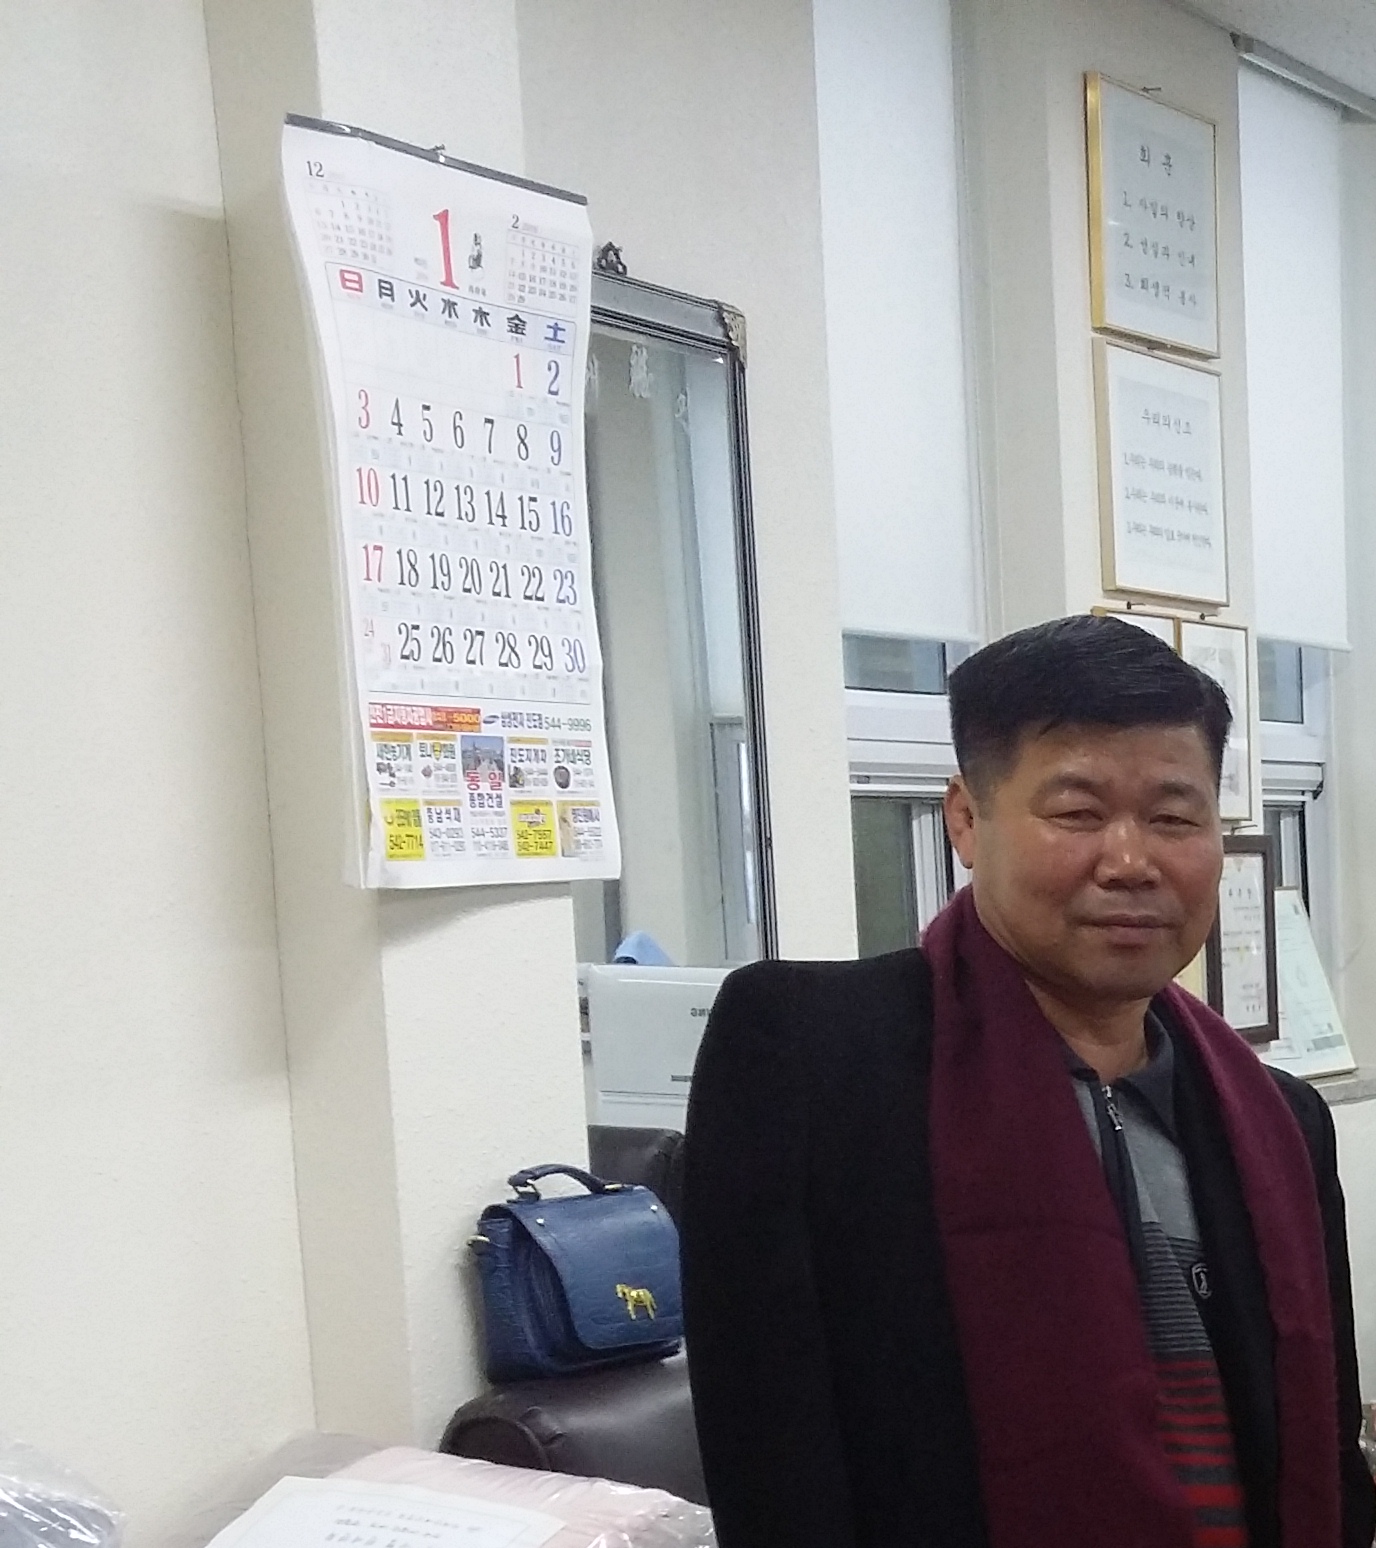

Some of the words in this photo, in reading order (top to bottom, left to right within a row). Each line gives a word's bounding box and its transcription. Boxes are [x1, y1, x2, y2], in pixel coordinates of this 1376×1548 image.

[306, 160, 324, 178] 12
[432, 209, 459, 290] 1
[511, 214, 520, 229] 2
[340, 268, 363, 293] 日
[377, 279, 395, 303] 月
[408, 288, 429, 312] 火
[441, 298, 459, 319] 水
[472, 306, 491, 327] 木
[506, 314, 528, 336] 金
[544, 322, 566, 344] 土
[514, 353, 524, 389] 1
[547, 360, 559, 396] 2
[358, 389, 370, 429] 3
[390, 397, 404, 437] 4
[421, 404, 433, 443] 5
[453, 411, 465, 449] 6
[484, 417, 495, 454] 7
[516, 424, 529, 461] 8
[549, 430, 562, 466] 9
[356, 467, 380, 507] 10
[390, 473, 413, 513] 11
[424, 478, 445, 518] 12
[454, 484, 476, 523] 13
[484, 489, 508, 528] 14
[518, 495, 541, 533] 15
[550, 500, 572, 537] 16
[362, 544, 384, 583] 17
[396, 549, 420, 588] 18
[429, 552, 451, 591] 19
[459, 556, 482, 595] 20
[489, 561, 512, 599] 21
[521, 565, 545, 602] 22
[553, 569, 577, 606] 23
[398, 622, 421, 662] 25
[431, 625, 454, 664] 26
[463, 628, 485, 667] 27
[495, 632, 521, 669] 28
[528, 634, 554, 671] 29
[561, 638, 586, 674] 30
